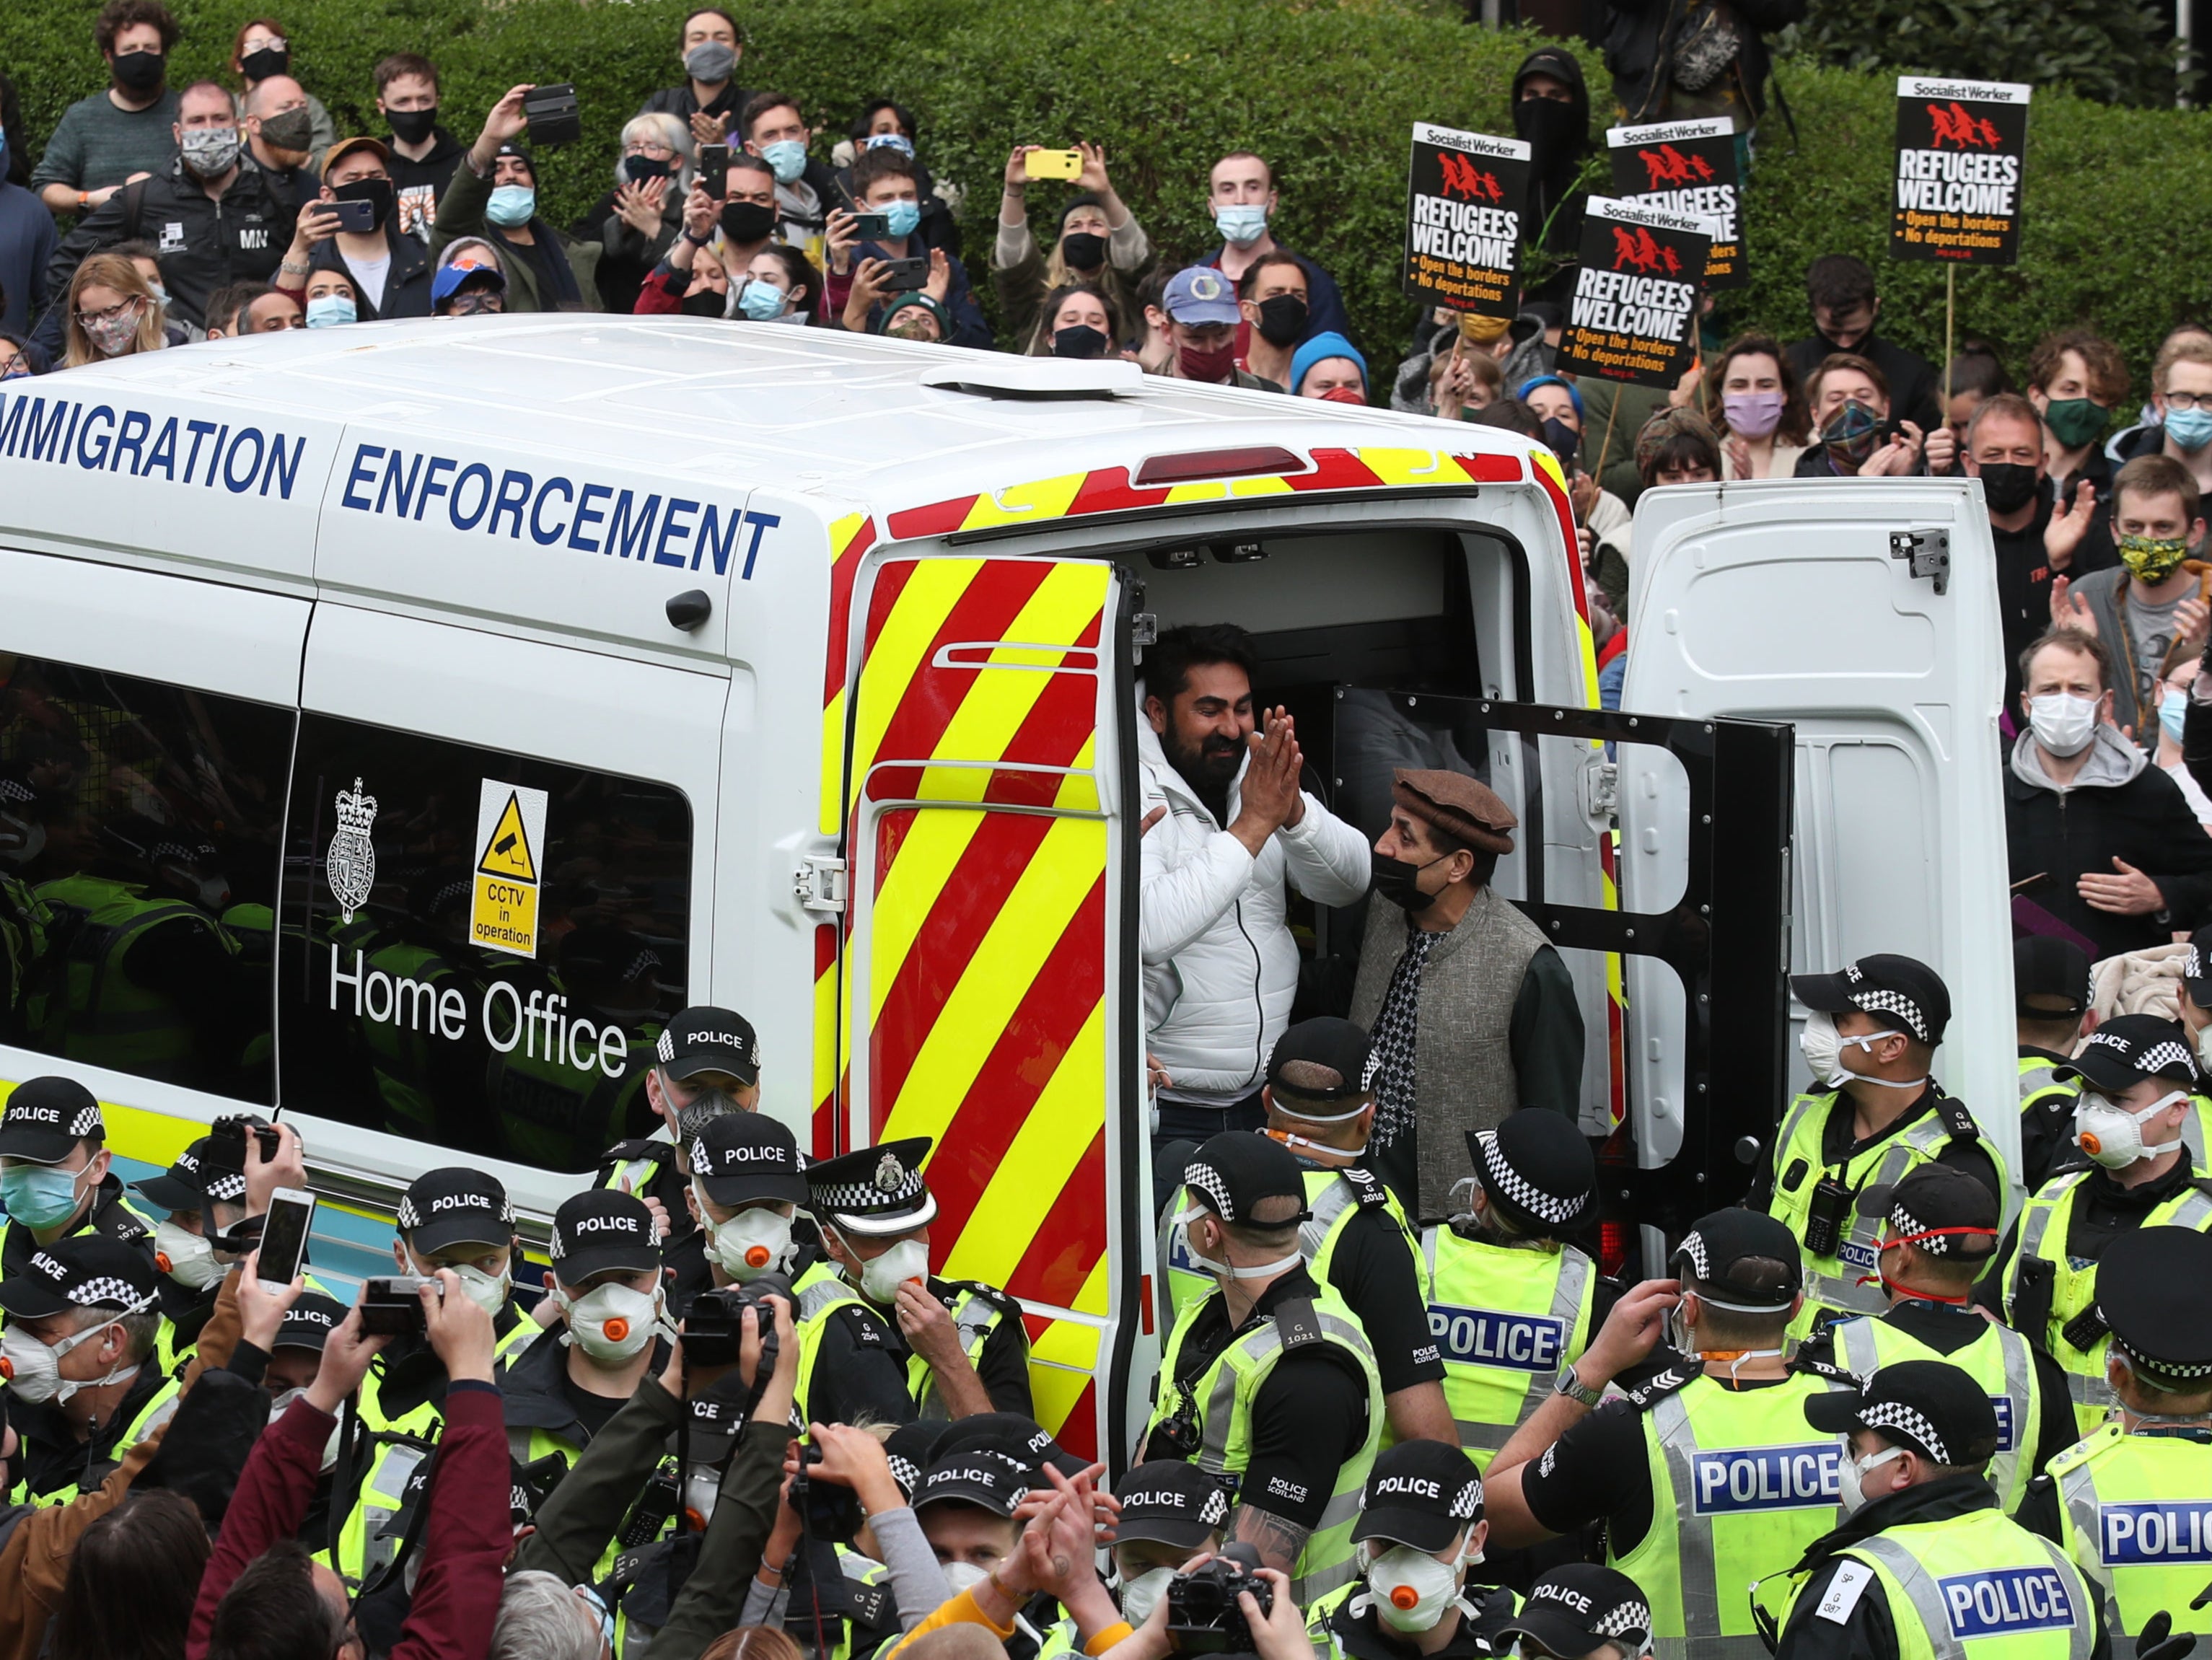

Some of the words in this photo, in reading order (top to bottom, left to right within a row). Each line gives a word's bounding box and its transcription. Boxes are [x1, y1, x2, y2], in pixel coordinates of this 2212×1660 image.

[1913, 82, 1967, 98] Socialist
[1968, 86, 2014, 101] Worker
[1427, 129, 1472, 151] Socialist
[1473, 139, 1516, 157] Worker
[1623, 128, 1674, 144] Socialist
[1675, 124, 1718, 136] Worker
[1899, 149, 2019, 186] REFUGEES
[1897, 179, 2015, 216] WELCOME
[1413, 193, 1519, 241] REFUGEES
[1602, 203, 1656, 224] Socialist
[1657, 213, 1701, 231] Worker
[1905, 210, 1936, 228] Open
[1940, 213, 1959, 229] the
[1962, 214, 2010, 232] borders
[1412, 222, 1515, 271] WELCOME
[1905, 227, 1923, 242] No
[1925, 229, 2002, 248] deportations
[1419, 255, 1445, 273] Open
[1447, 263, 1463, 278] the
[1467, 265, 1510, 286] borders
[1418, 271, 1433, 288] No
[1435, 276, 1502, 302] deportations
[1575, 267, 1695, 313] REFUGEES
[1571, 296, 1688, 342] WELCOME
[1576, 328, 1605, 346] Open
[1608, 333, 1628, 350] the
[1631, 336, 1676, 357] borders
[1572, 343, 1589, 360] No
[1592, 348, 1666, 372] deportations
[0, 392, 306, 500] MMIGRATION
[342, 444, 781, 580] ENFORCEMENT
[488, 883, 525, 907] CCTV
[499, 906, 510, 923] in
[476, 923, 531, 946] operation
[330, 943, 467, 1040] Home
[483, 981, 627, 1078] Office
[687, 1031, 742, 1050] POLICE
[8, 1106, 61, 1123] POLICE
[177, 1153, 199, 1174] OLIC
[725, 1146, 786, 1164] POLICE
[432, 1193, 491, 1211] POLICE
[1362, 1193, 1385, 1203] 2010
[576, 1216, 638, 1236] POLICE
[1839, 1244, 1874, 1265] POLIC
[30, 1252, 69, 1281] OLICE
[283, 1309, 333, 1327] OLICE
[1288, 1332, 1315, 1345] 1021
[1426, 1312, 1556, 1364] POLICE
[1413, 1345, 1438, 1357] POLICE
[1414, 1352, 1440, 1364] SCOTLAND
[1643, 1386, 1652, 1395] G
[927, 1468, 995, 1487] POLICE
[1270, 1476, 1308, 1497] POLICE
[1376, 1477, 1441, 1498] POLICE
[1700, 1452, 1839, 1505] POLICE
[1123, 1491, 1185, 1509] POLICE
[1267, 1485, 1305, 1503] SCOTLAND
[2107, 1511, 2212, 1555] POLI
[629, 1558, 638, 1567] G
[854, 1594, 865, 1602] G
[864, 1592, 882, 1620] 1141
[1531, 1584, 1592, 1614] POLICE
[1833, 1593, 1841, 1602] G
[1952, 1571, 2069, 1629] POLICE
